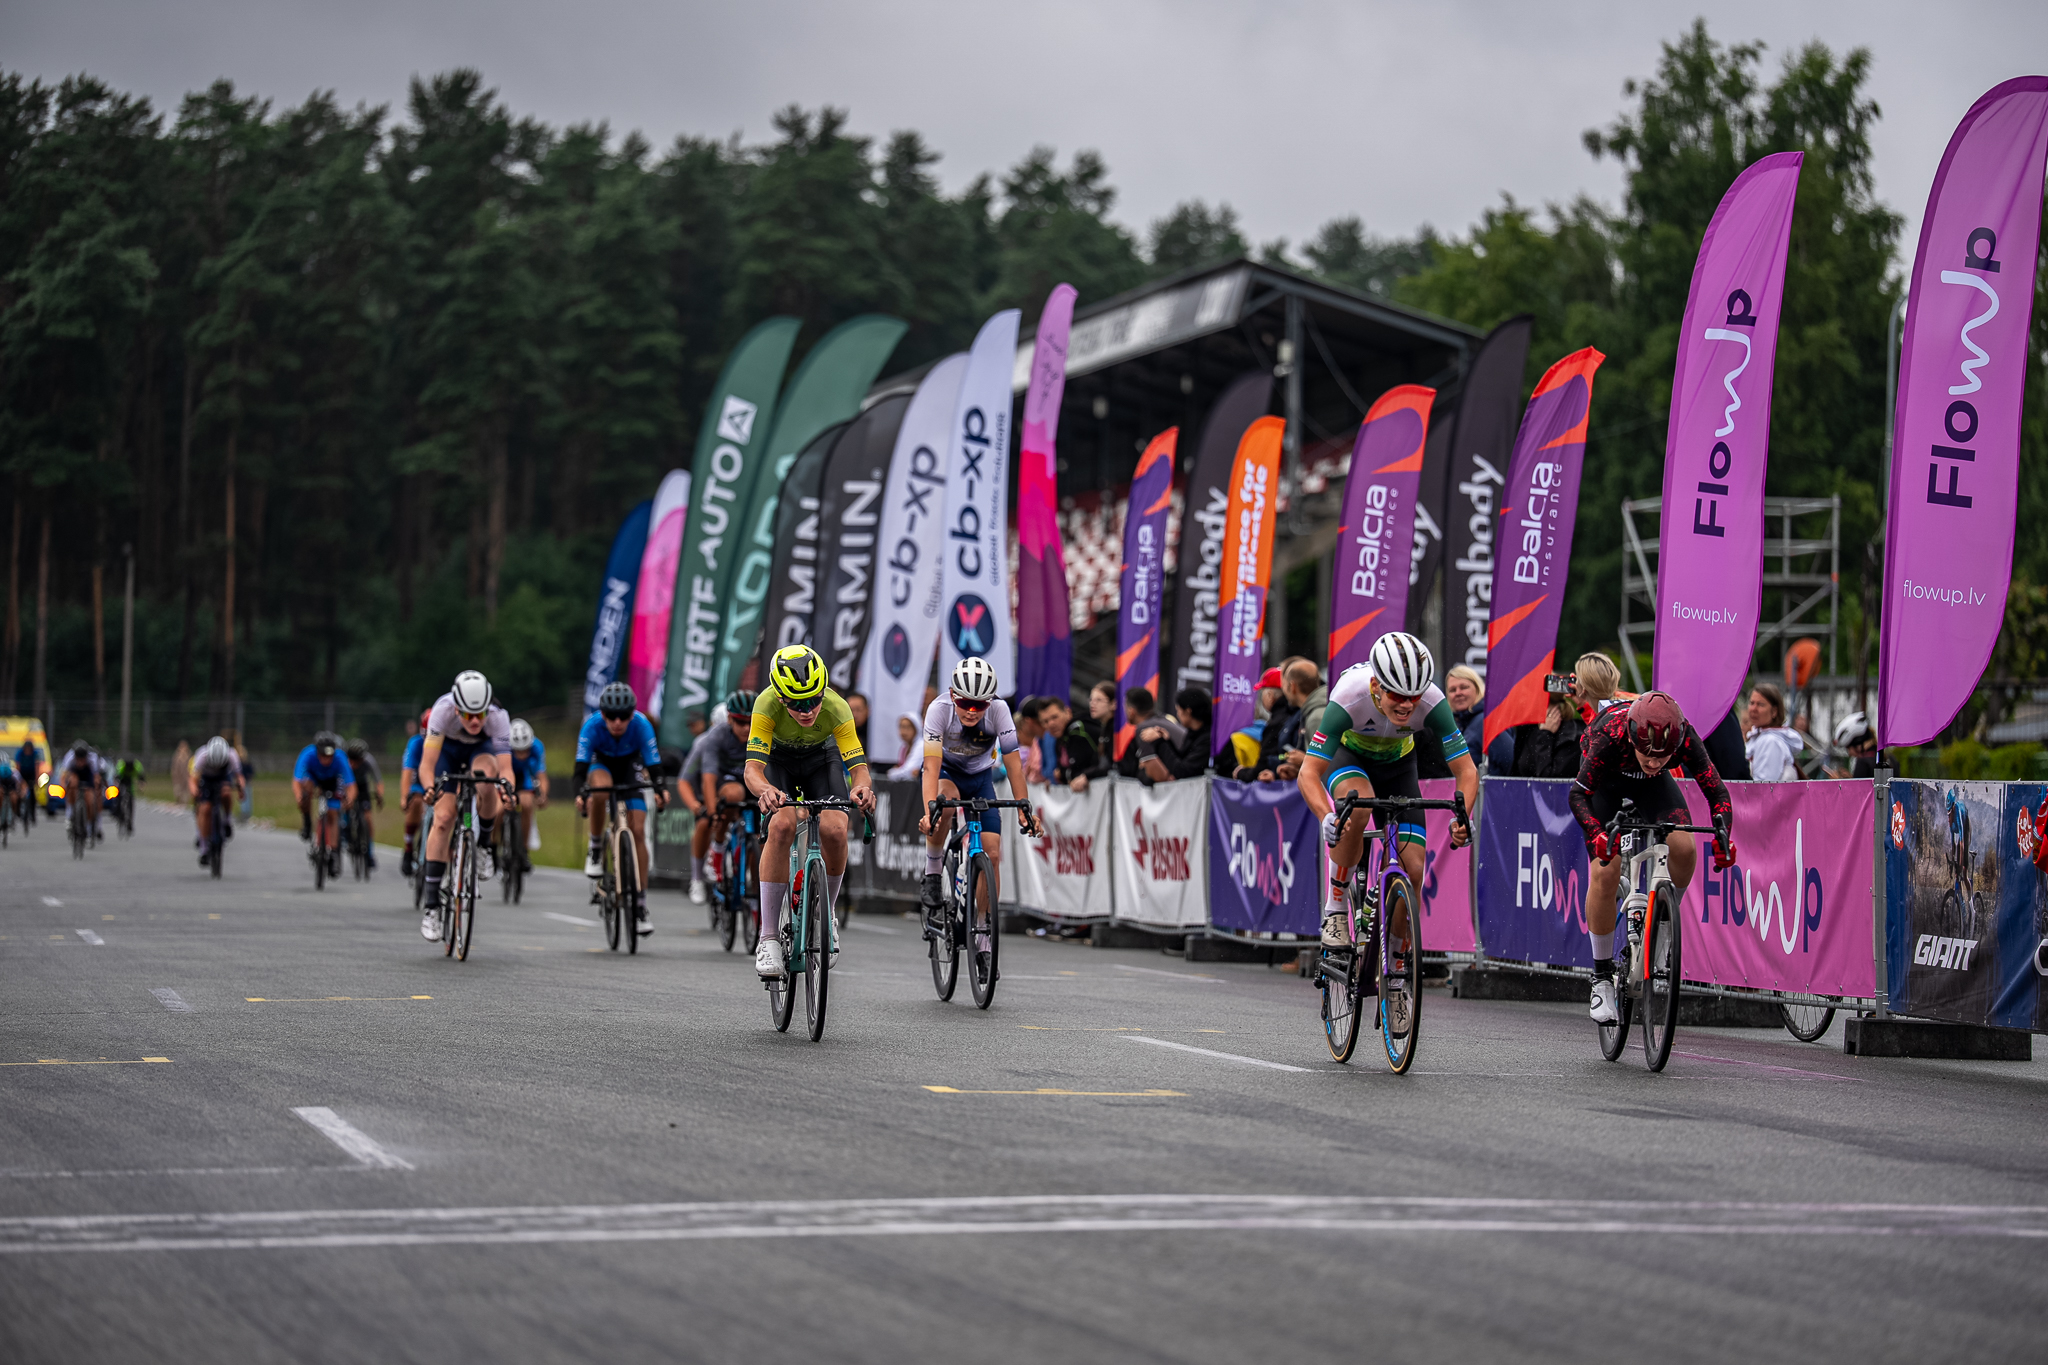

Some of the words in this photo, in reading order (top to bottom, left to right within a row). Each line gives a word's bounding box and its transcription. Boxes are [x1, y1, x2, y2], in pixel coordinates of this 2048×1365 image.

[697, 443, 744, 571] AUTO
[888, 444, 947, 608] cb-xp
[949, 405, 992, 579] cb-xp
[1239, 458, 1256, 503] for
[1245, 463, 1268, 583] lifestyle
[1351, 484, 1388, 598] Balcia
[1513, 462, 1554, 584] Balcia
[1541, 463, 1563, 587] insurance
[777, 496, 820, 648] RMIN
[829, 480, 882, 690] ARMIN
[1131, 524, 1154, 625] Balcia
[1228, 509, 1252, 655] Insurance
[1377, 487, 1399, 600] insurance
[1455, 453, 1505, 677] herabody
[1903, 579, 1986, 607] flowup.lv
[583, 577, 630, 711] ENDEN
[678, 574, 720, 709] VERTE
[1672, 601, 1738, 626] flowup.lv
[1914, 933, 1978, 971] GIANT
